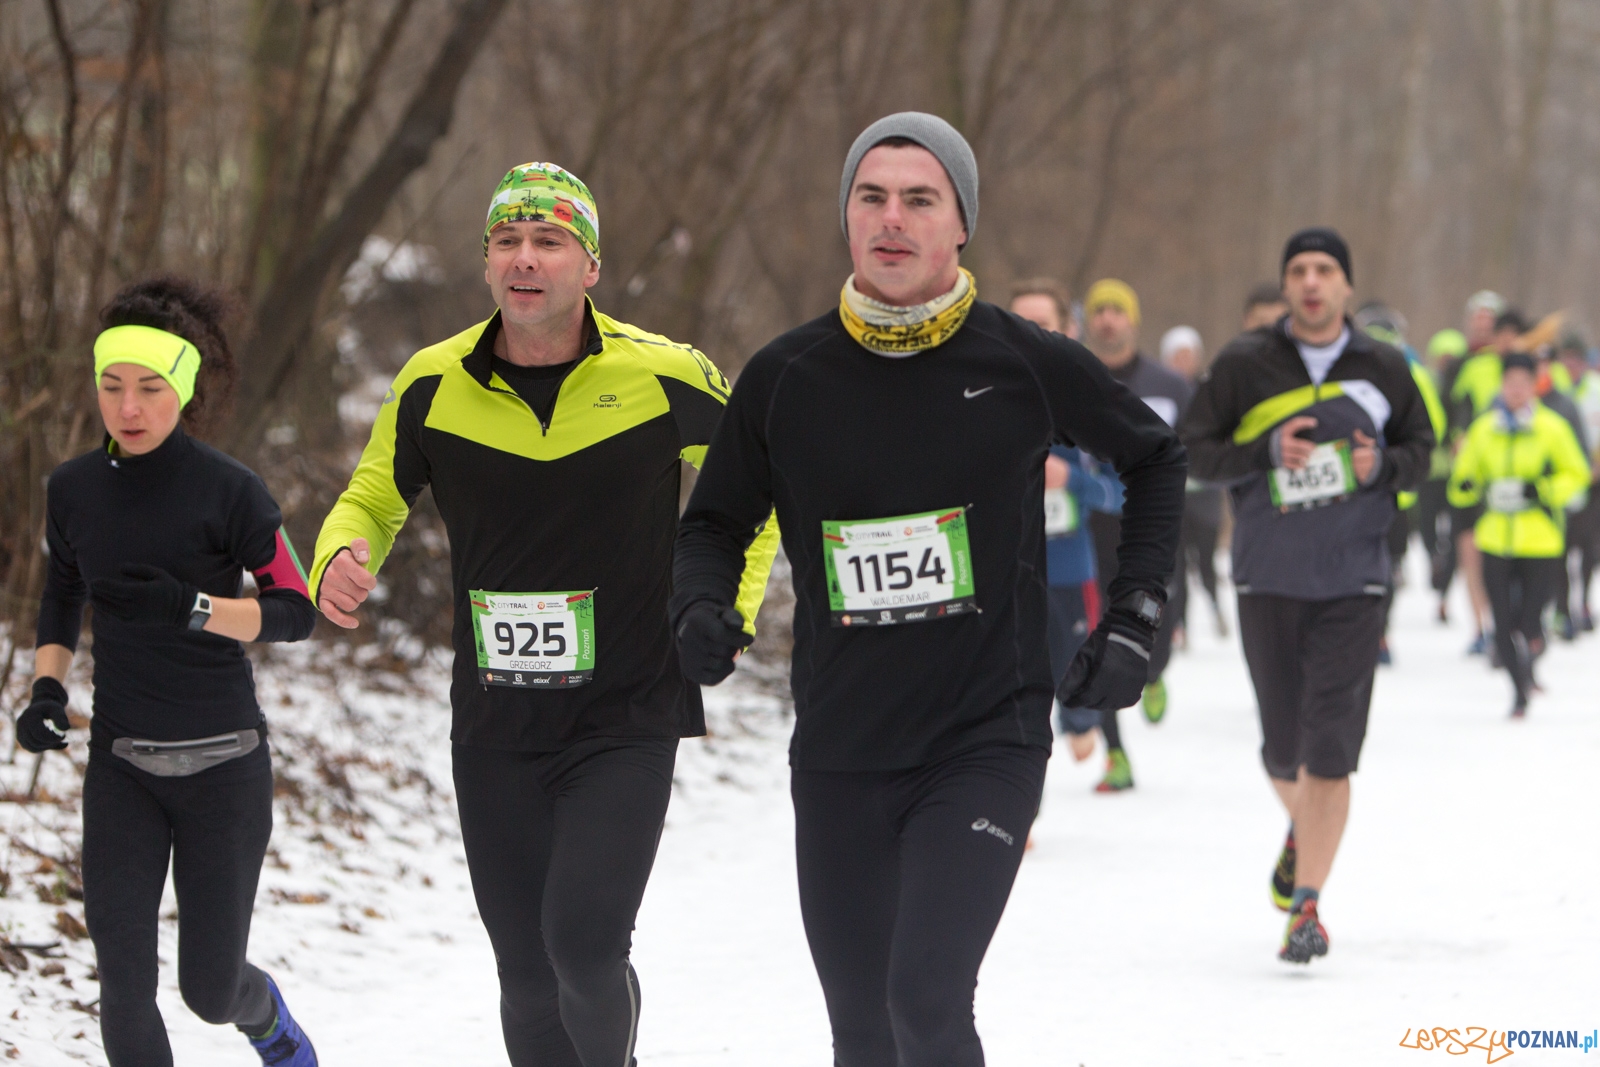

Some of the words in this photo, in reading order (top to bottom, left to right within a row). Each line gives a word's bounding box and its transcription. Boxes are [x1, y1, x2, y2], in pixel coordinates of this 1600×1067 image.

[1288, 462, 1338, 487] 465
[848, 547, 946, 593] 1154
[870, 591, 931, 607] WALDEMAR
[494, 621, 566, 657] 925
[582, 628, 590, 660] Poznań
[509, 660, 552, 670] GRZEGORZ
[987, 823, 1015, 846] asics
